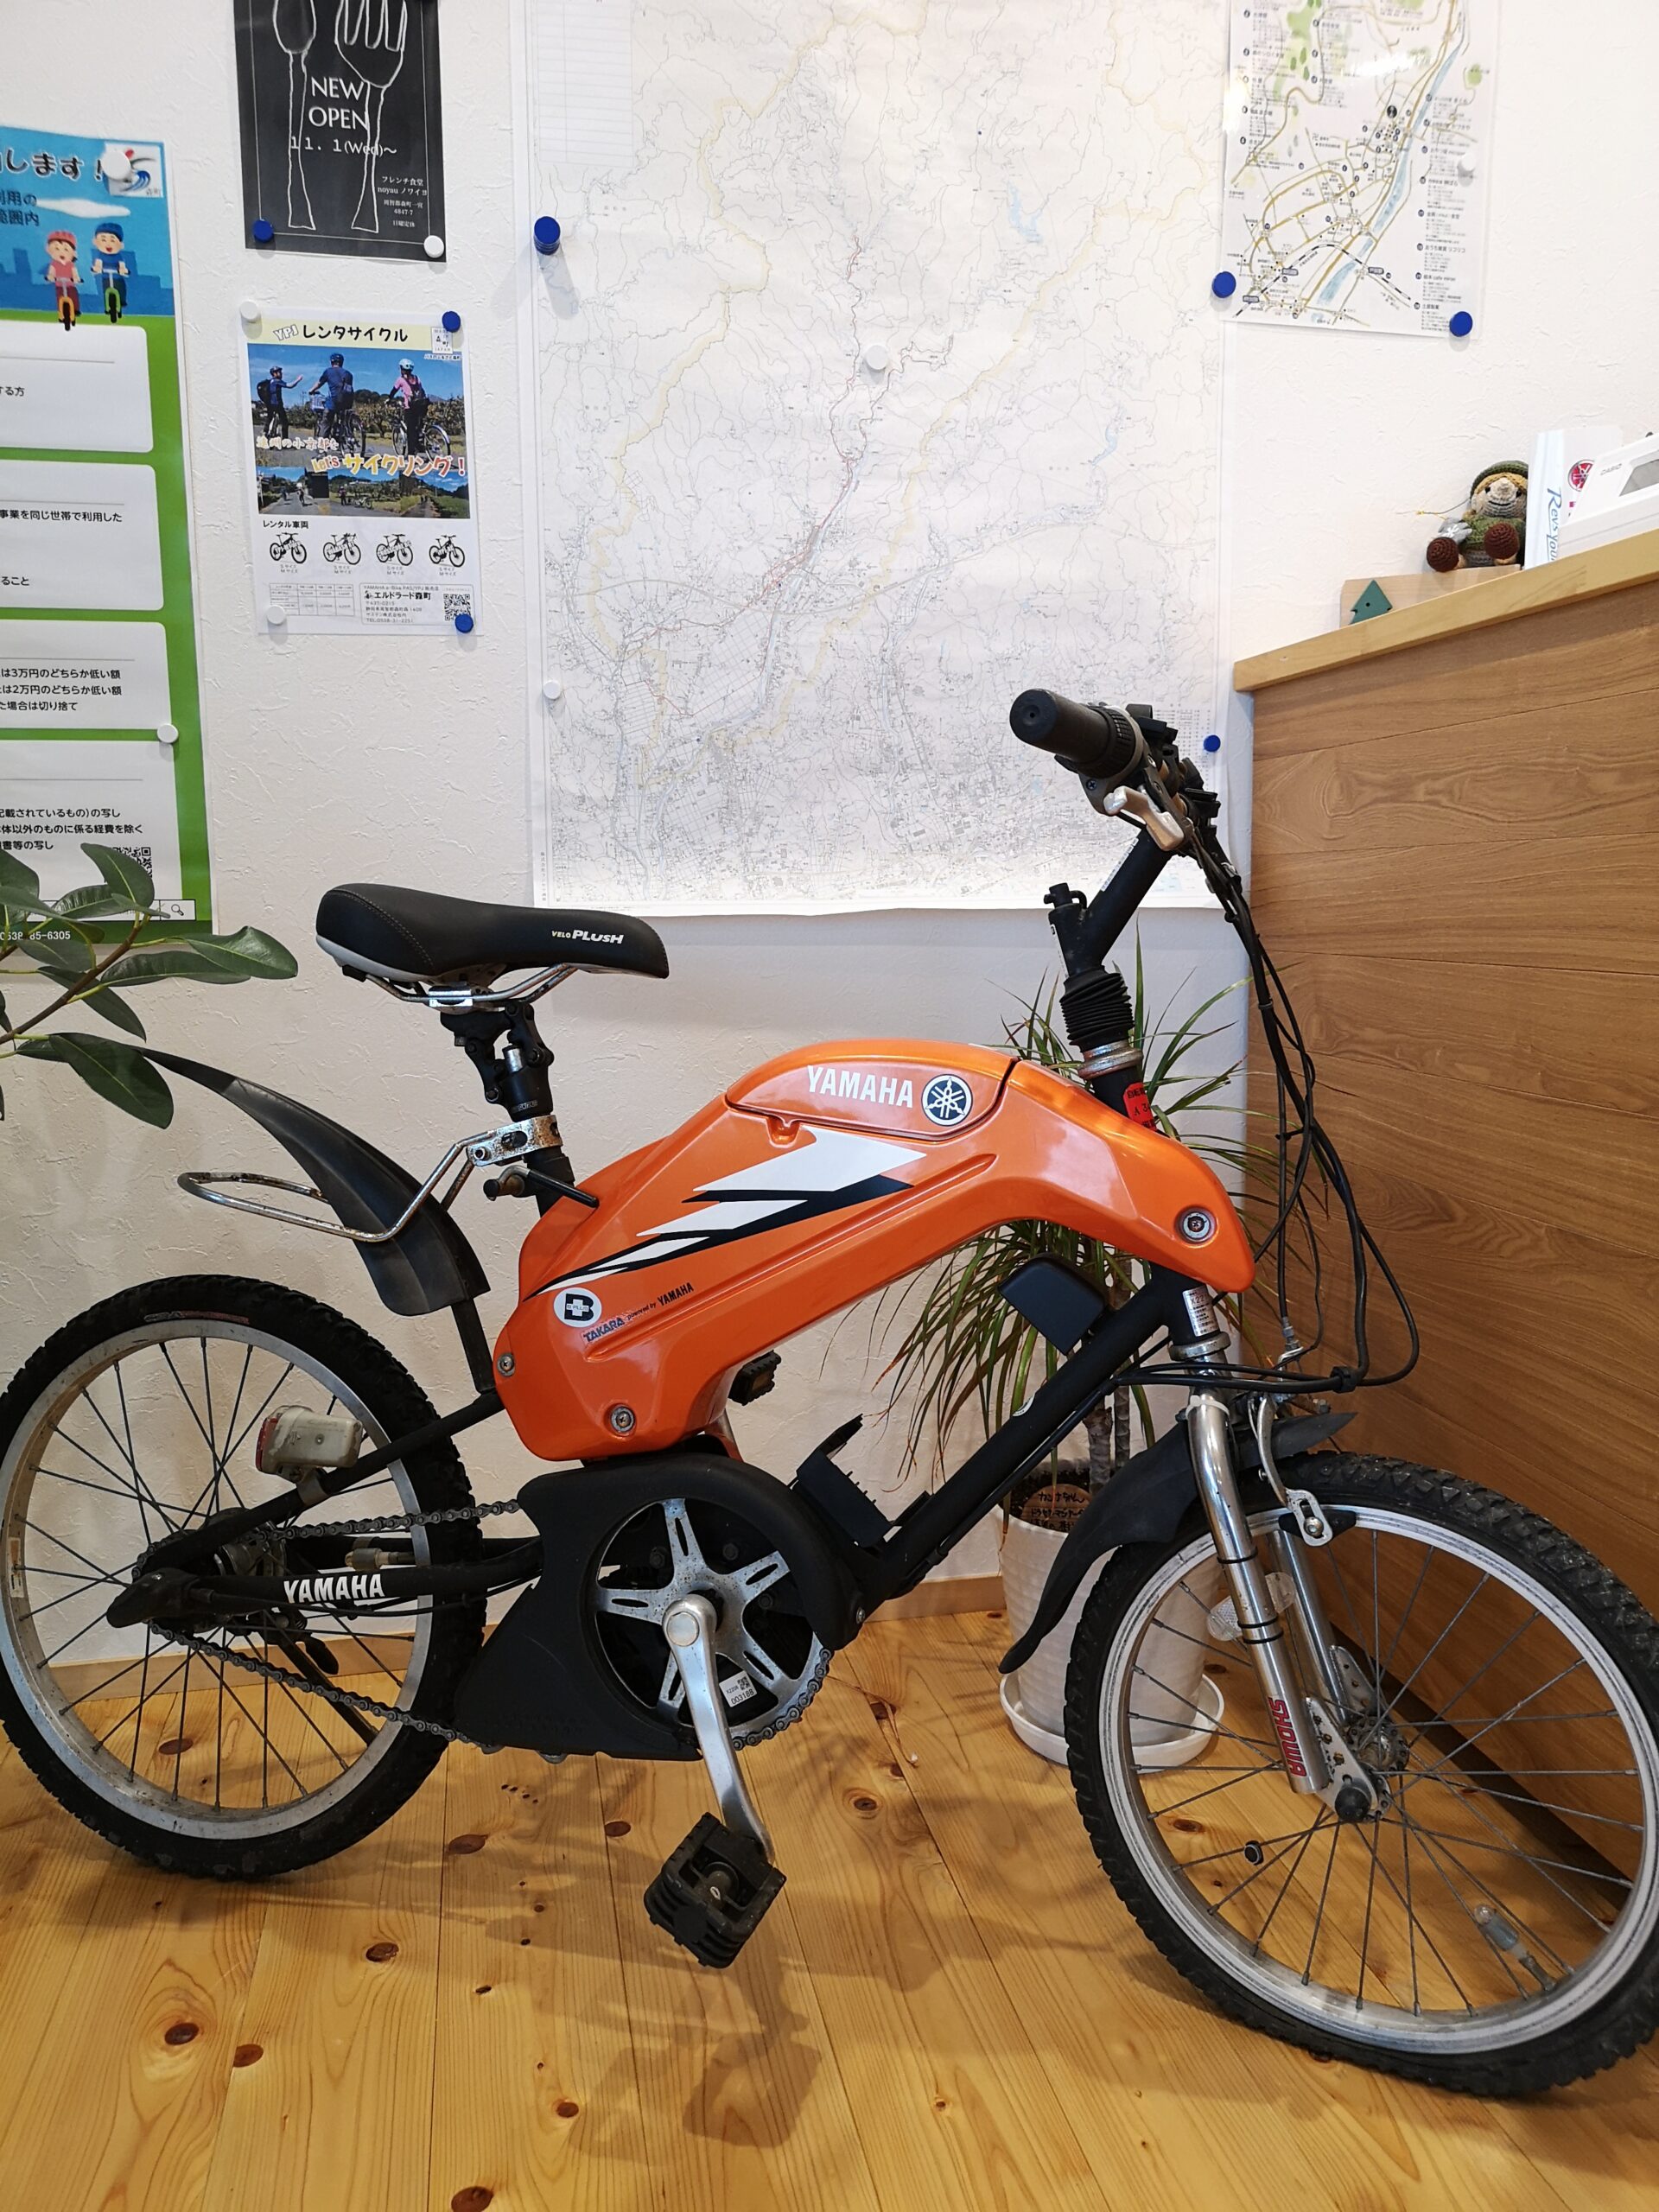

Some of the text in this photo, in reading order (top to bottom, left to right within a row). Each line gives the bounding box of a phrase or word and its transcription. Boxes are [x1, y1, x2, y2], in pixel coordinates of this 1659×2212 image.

[311, 76, 365, 100] NEW
[308, 106, 370, 130] OPEN
[382, 176, 424, 186] フレンチ食堂
[273, 324, 408, 342] YPJ レンタサイクル
[263, 520, 308, 529] レンタル車両
[1, 575, 30, 586] ること
[374, 592, 431, 601] エルドラード森町
[0, 684, 122, 696] は2万円のどちらか低い額
[0, 824, 143, 834] 体以外のものに係る経費を除く
[0, 840, 54, 850] 書等の写し
[551, 929, 625, 944] VELO PLUSH
[806, 1065, 913, 1109] YAMAHA
[583, 1317, 626, 1342] TAKARA
[627, 1305, 650, 1321] powered
[658, 1282, 694, 1306] YAMAHA
[283, 1573, 385, 1604] YAMAHA
[1268, 1696, 1307, 1777] SHOWA
